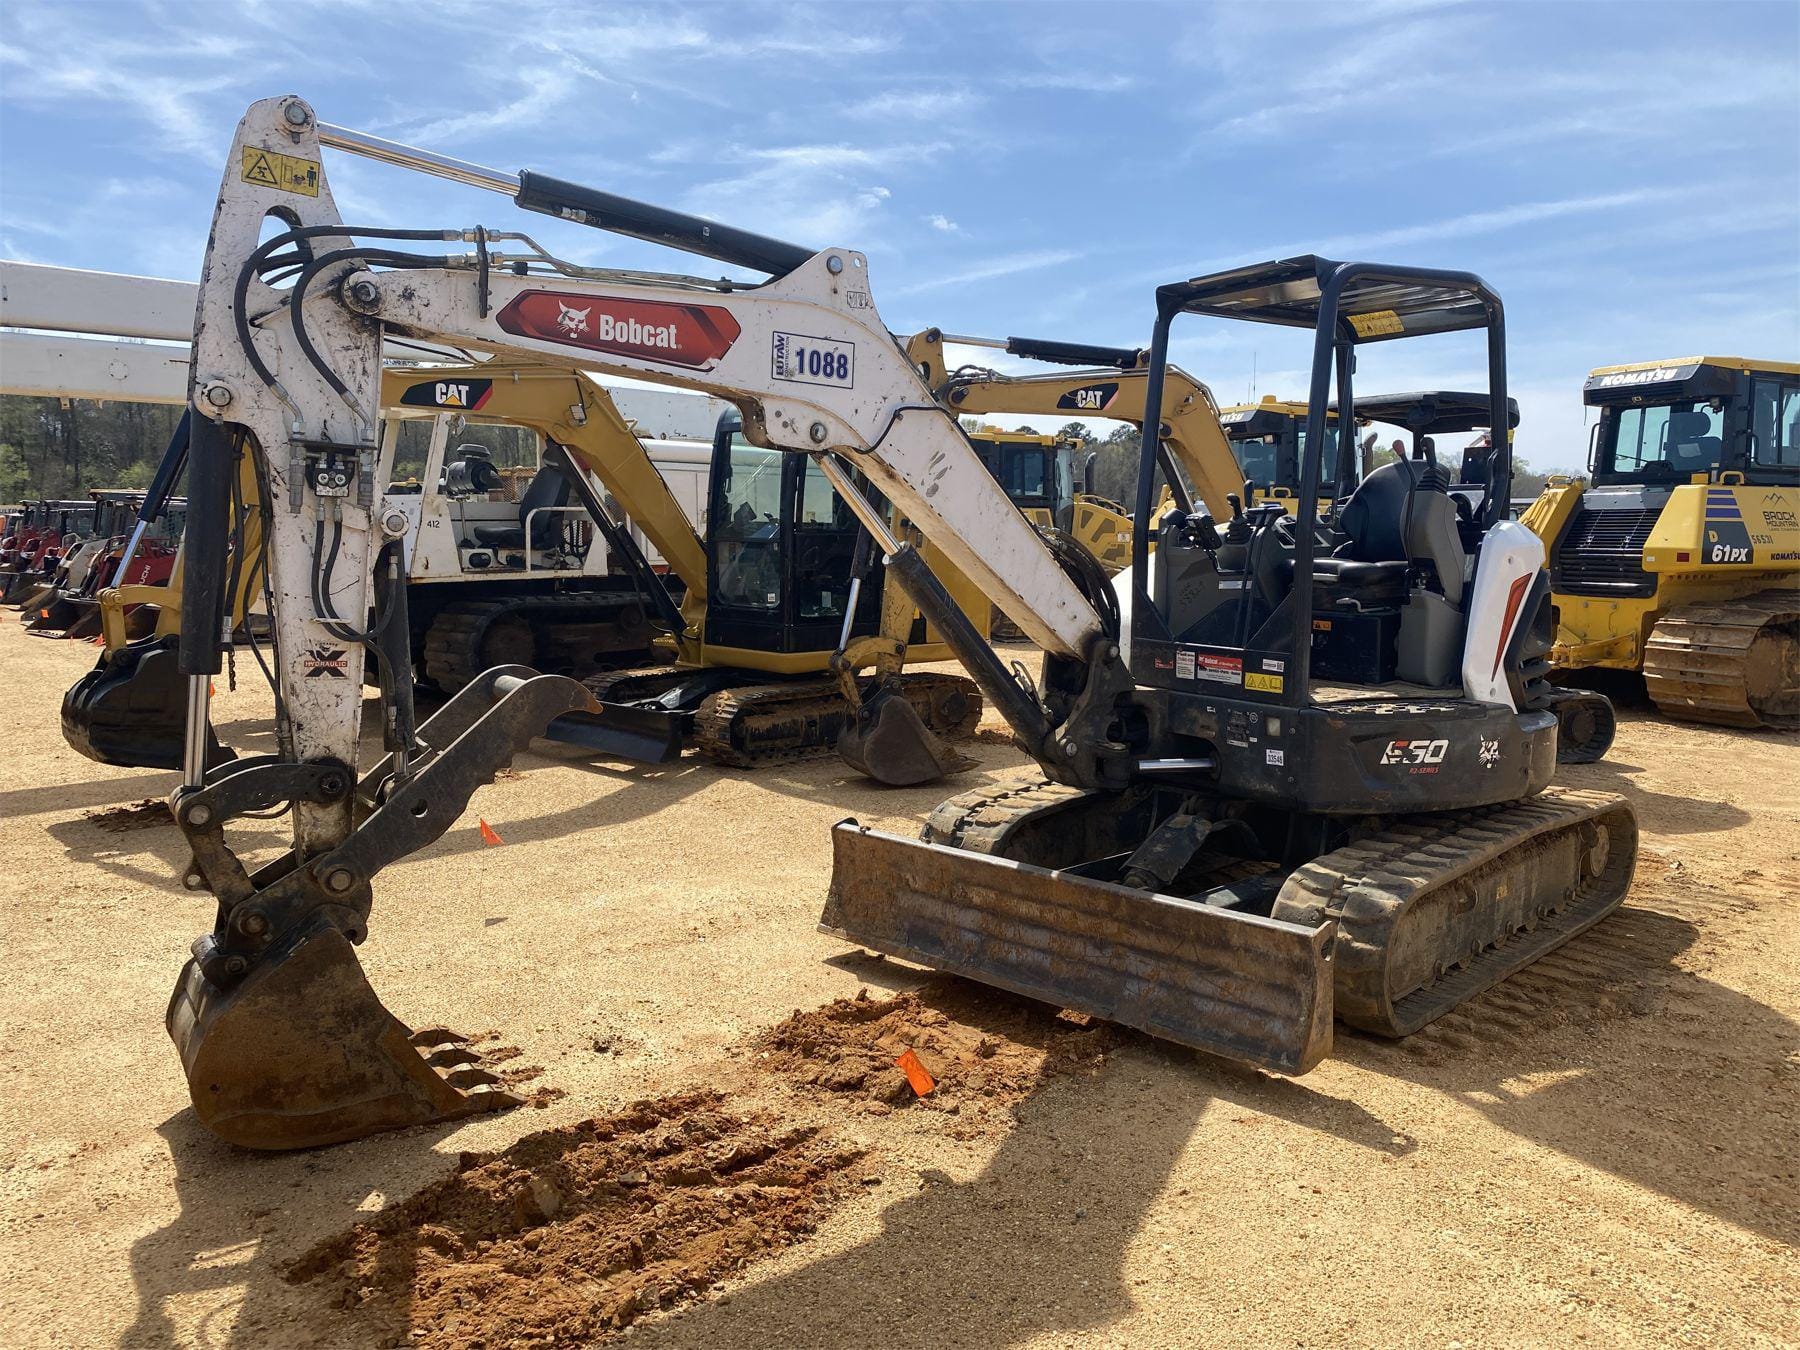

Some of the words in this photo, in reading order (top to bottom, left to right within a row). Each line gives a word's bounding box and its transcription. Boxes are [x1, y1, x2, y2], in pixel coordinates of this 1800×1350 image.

[599, 314, 678, 350] Bobcat
[774, 334, 786, 376] EUTAW
[796, 347, 847, 379] 1088
[1600, 369, 1678, 386] KOMATSU
[435, 383, 469, 406] CAT
[1077, 390, 1102, 409] CAT
[1219, 412, 1245, 424] ATSU
[426, 519, 440, 529] 412
[1762, 510, 1796, 521] BROCK
[1765, 520, 1800, 528] MOUNTAIN
[1708, 530, 1719, 543] D
[1711, 544, 1749, 562] 61PX
